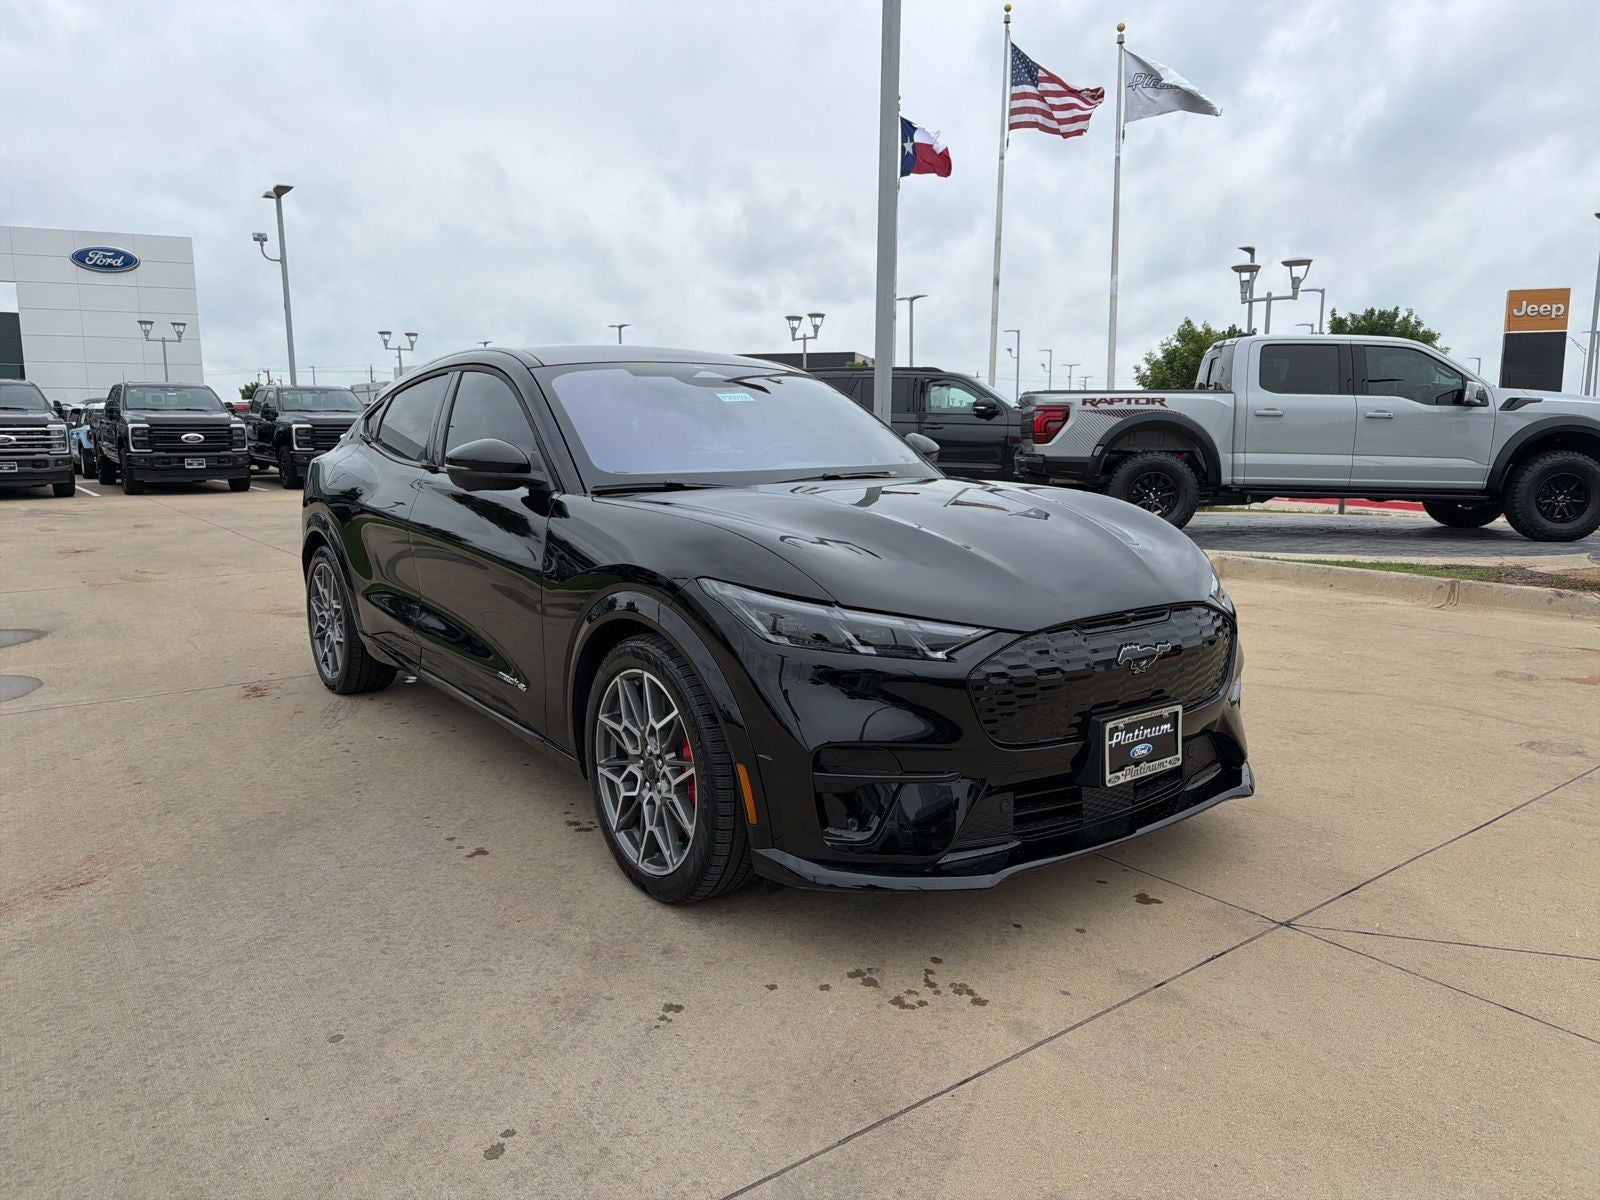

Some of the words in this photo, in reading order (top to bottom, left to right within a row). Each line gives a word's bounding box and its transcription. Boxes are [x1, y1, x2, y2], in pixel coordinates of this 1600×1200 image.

[85, 250, 124, 266] Ford
[1512, 300, 1565, 319] Jeep
[1081, 397, 1168, 408] RAPTOR
[1108, 722, 1174, 747] Platinum
[1123, 762, 1167, 780] Platinum
